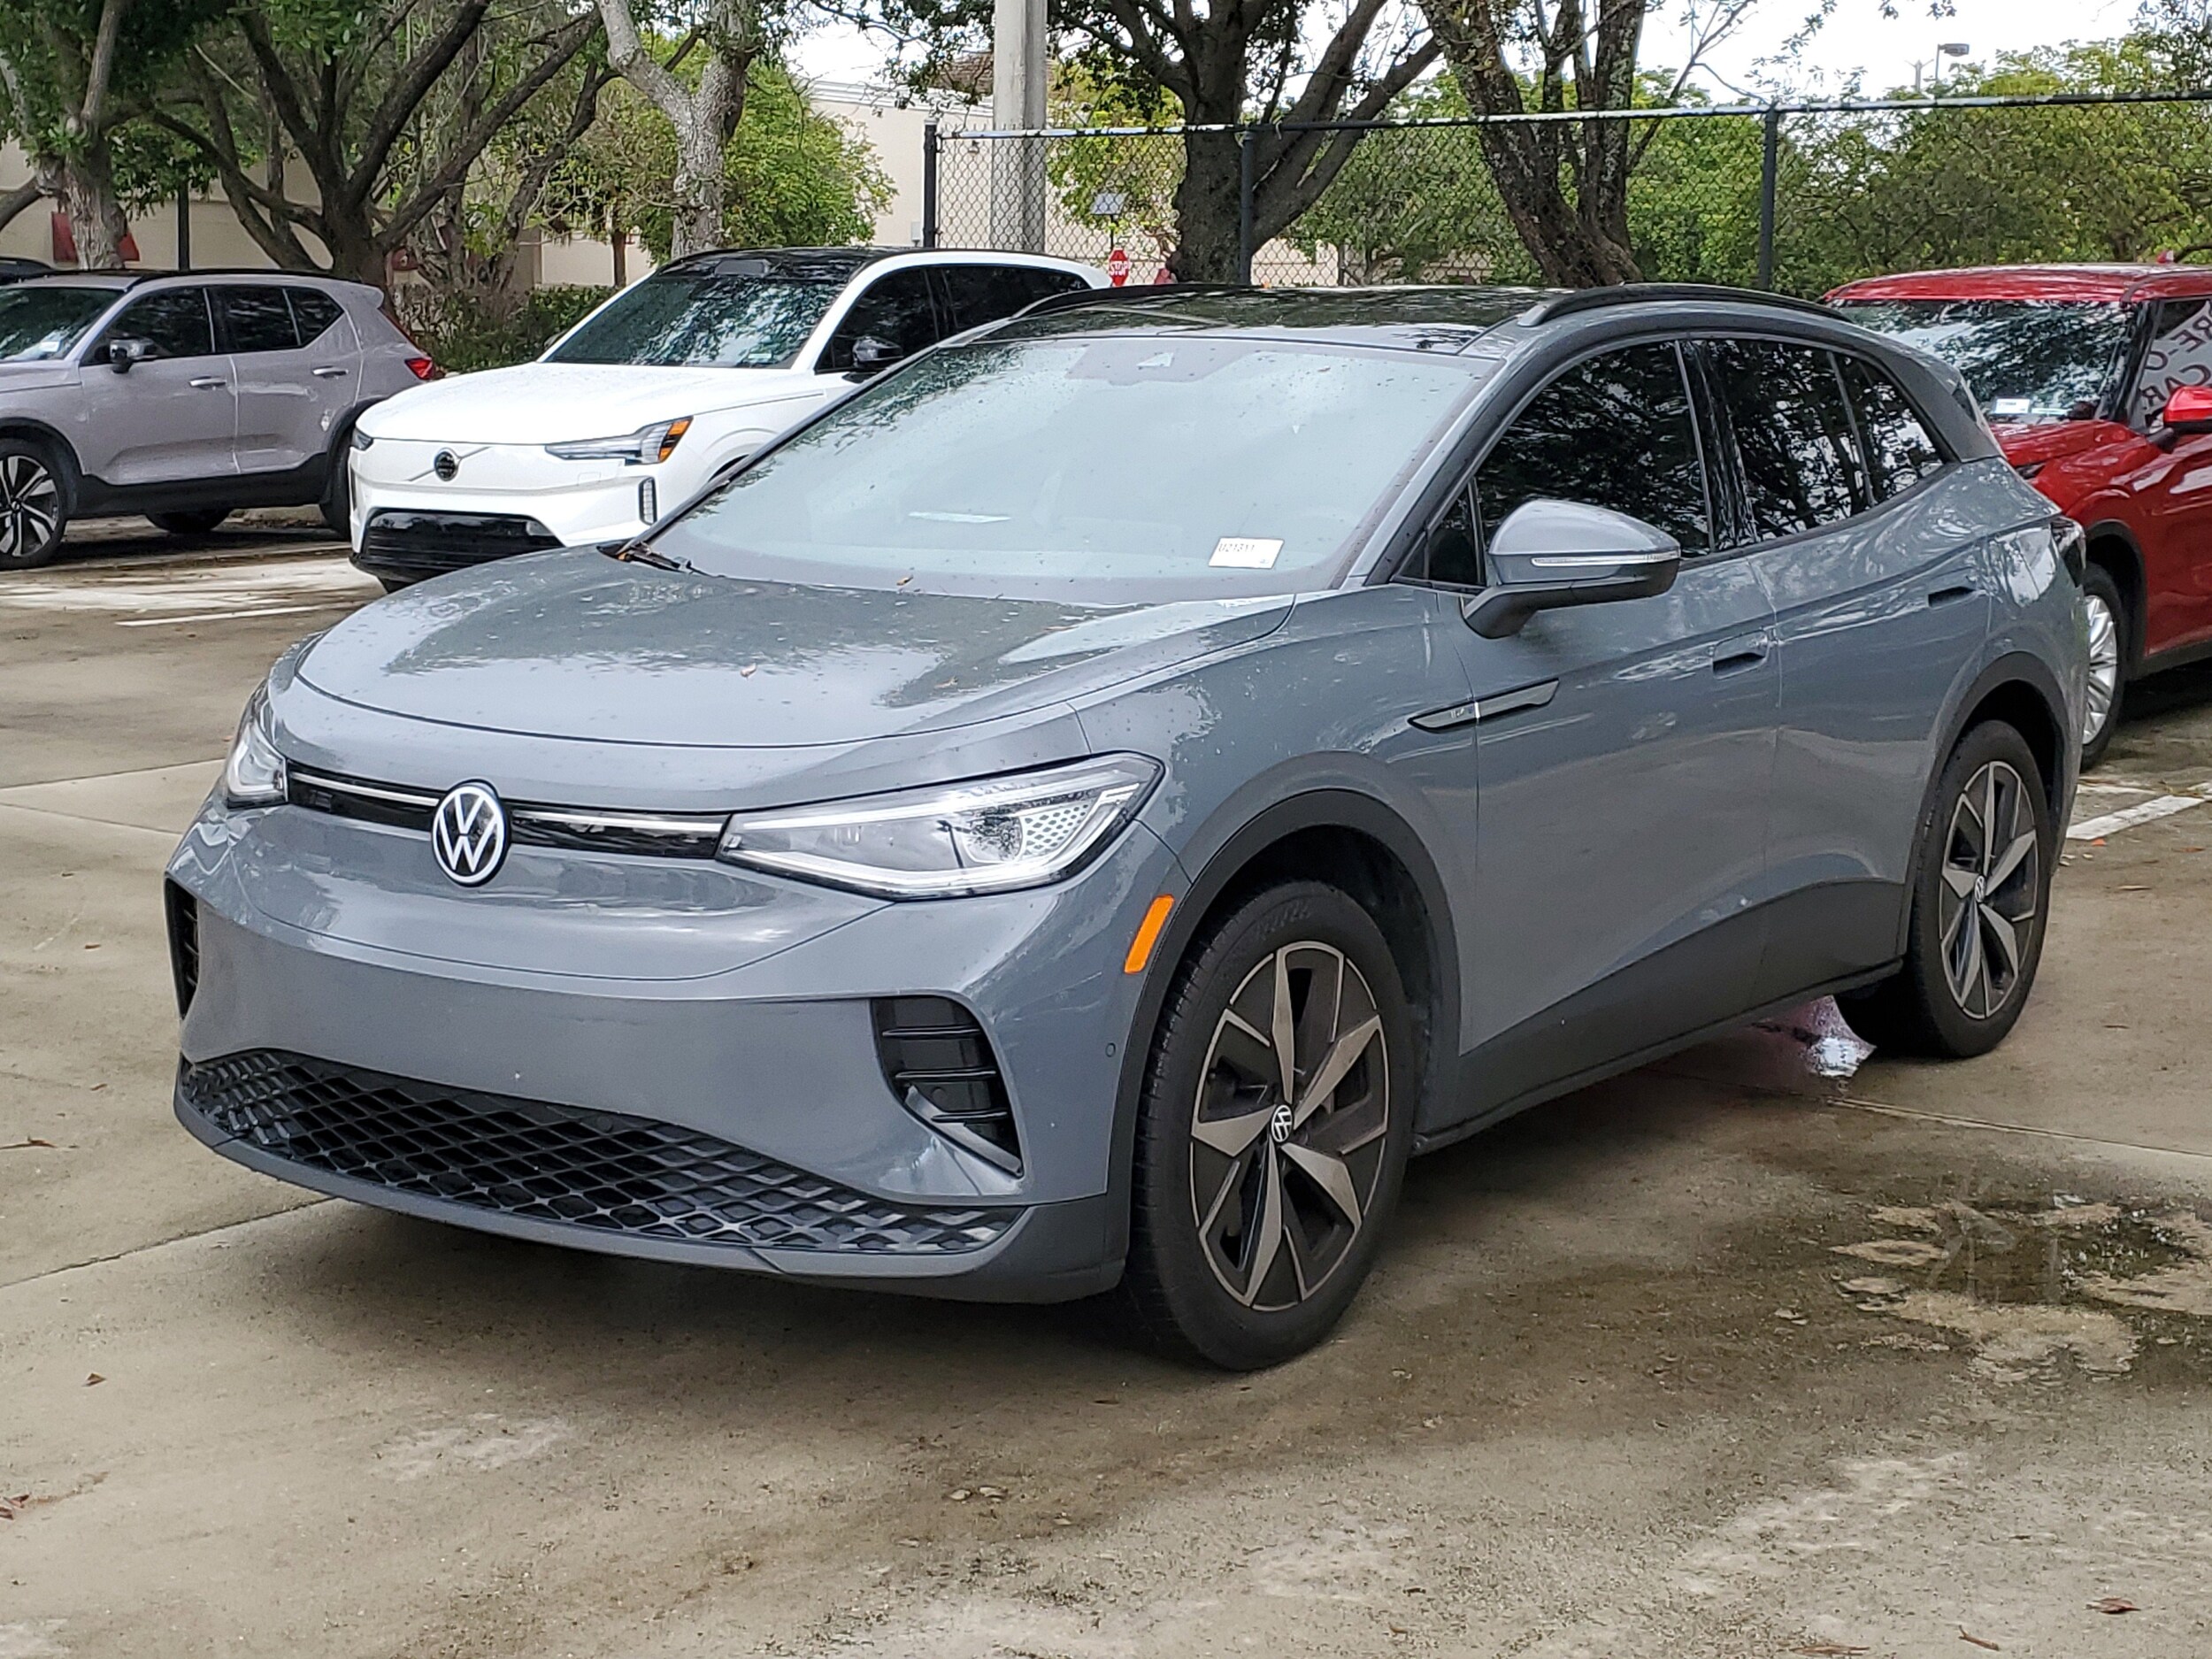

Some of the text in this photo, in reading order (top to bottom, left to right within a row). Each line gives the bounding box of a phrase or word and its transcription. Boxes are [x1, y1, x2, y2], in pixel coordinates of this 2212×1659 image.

[1109, 260, 1129, 275] STOP
[434, 787, 503, 879] VW
[1271, 1105, 1293, 1142] VW
